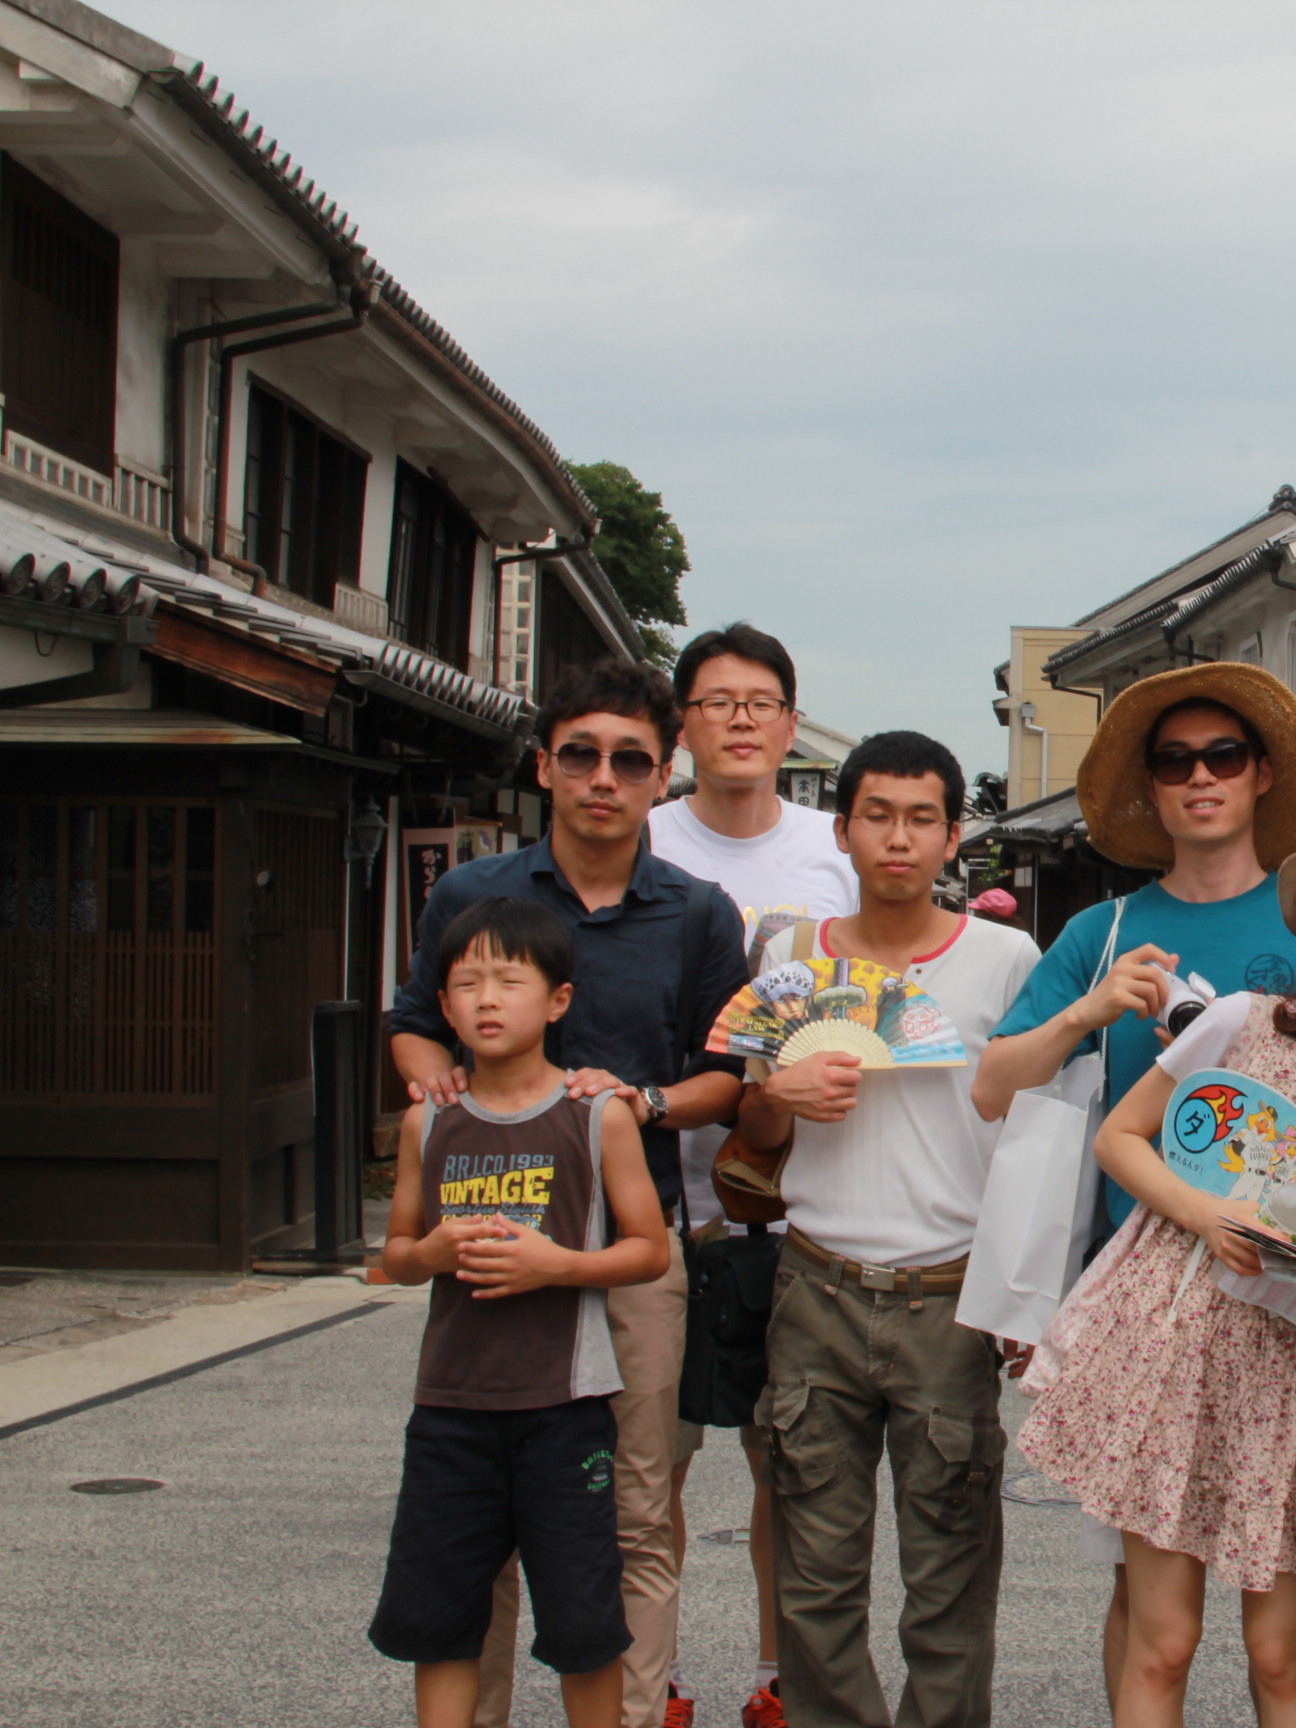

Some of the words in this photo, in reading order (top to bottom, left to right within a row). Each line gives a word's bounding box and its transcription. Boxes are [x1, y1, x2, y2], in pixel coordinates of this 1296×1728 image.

[1183, 1110, 1211, 1137] ダ
[509, 1153, 554, 1171] 1993
[440, 1166, 554, 1205] VINTAGE
